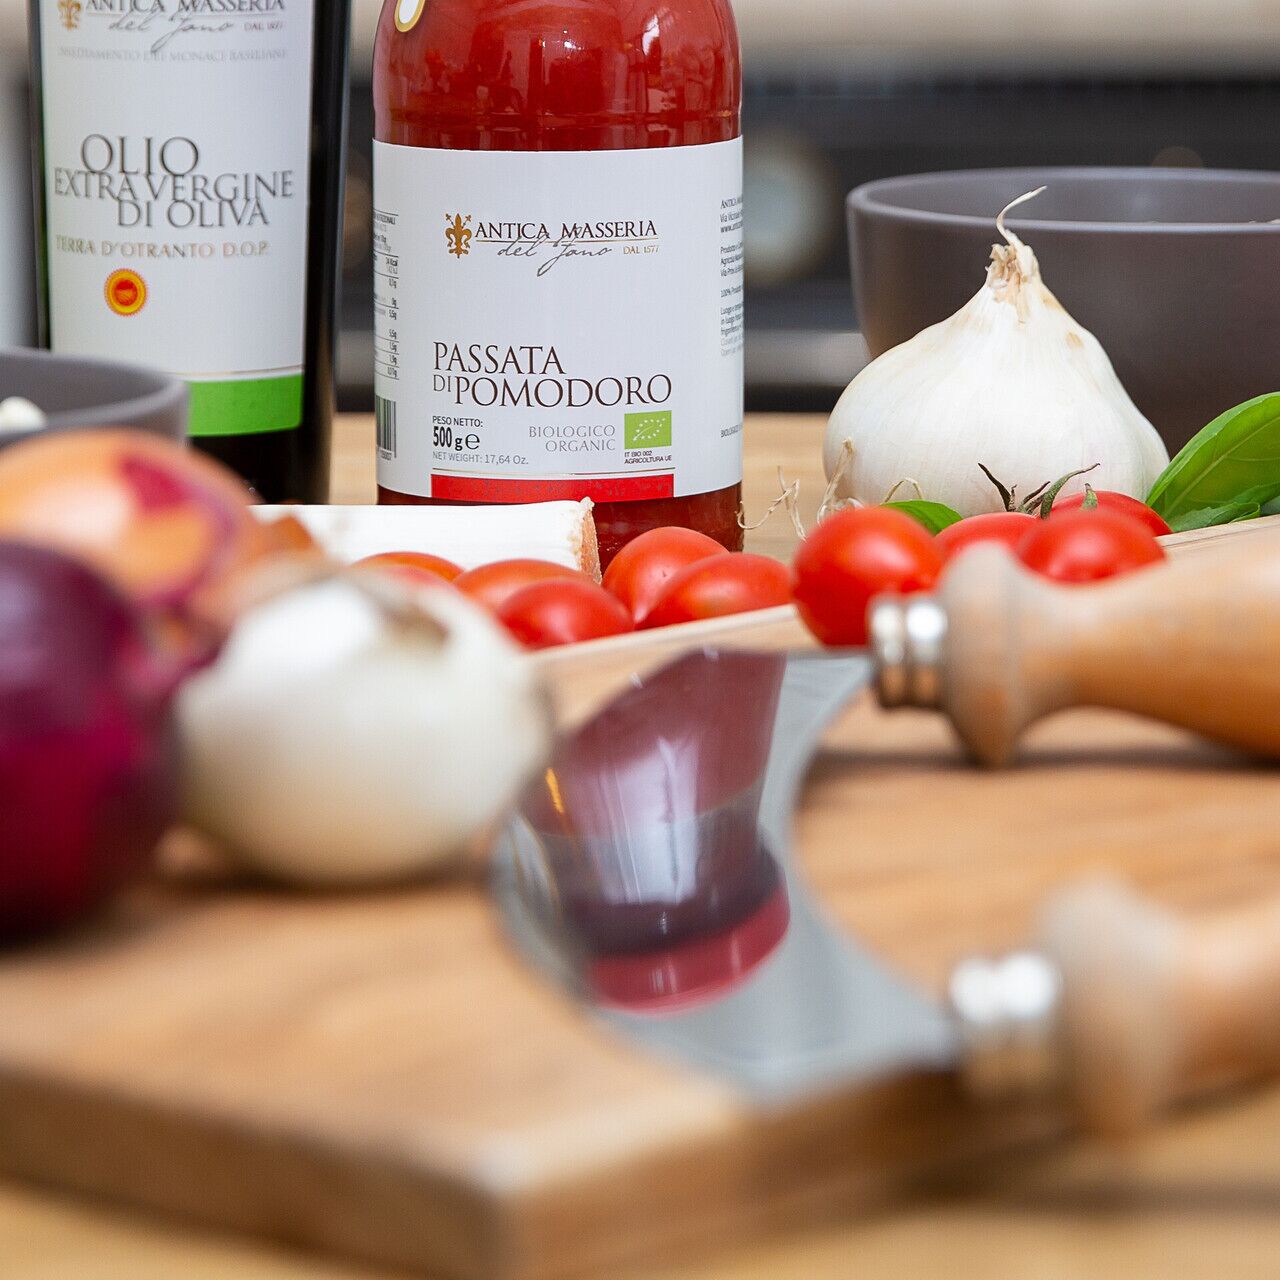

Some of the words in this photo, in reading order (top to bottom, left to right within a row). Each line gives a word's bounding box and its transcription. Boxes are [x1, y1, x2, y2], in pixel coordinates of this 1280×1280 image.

[81, 133, 199, 176] OLIO
[53, 167, 139, 201] EXTRA
[144, 169, 293, 202] VERGINE
[117, 199, 152, 228] DI
[166, 198, 270, 229] OLIVA
[475, 221, 551, 239] ANTICA
[561, 219, 658, 239] MASSERIA
[56, 234, 94, 255] TERRA
[101, 241, 215, 258] D'OTRANTO
[497, 233, 550, 257] del
[623, 245, 640, 254] DAL
[433, 341, 567, 375] PASSATA
[433, 374, 452, 393] DI
[454, 373, 673, 408] POMODORO
[433, 416, 452, 425] PESO
[453, 417, 483, 427] NETTO:
[528, 424, 616, 438] BIOLOGICO
[433, 426, 452, 448] 500
[545, 439, 616, 452] ORGANIC
[433, 451, 447, 460] NET
[448, 452, 483, 463] WEIGHT:
[485, 454, 511, 465] 17,64
[624, 456, 664, 465] AGRICOLTURA
